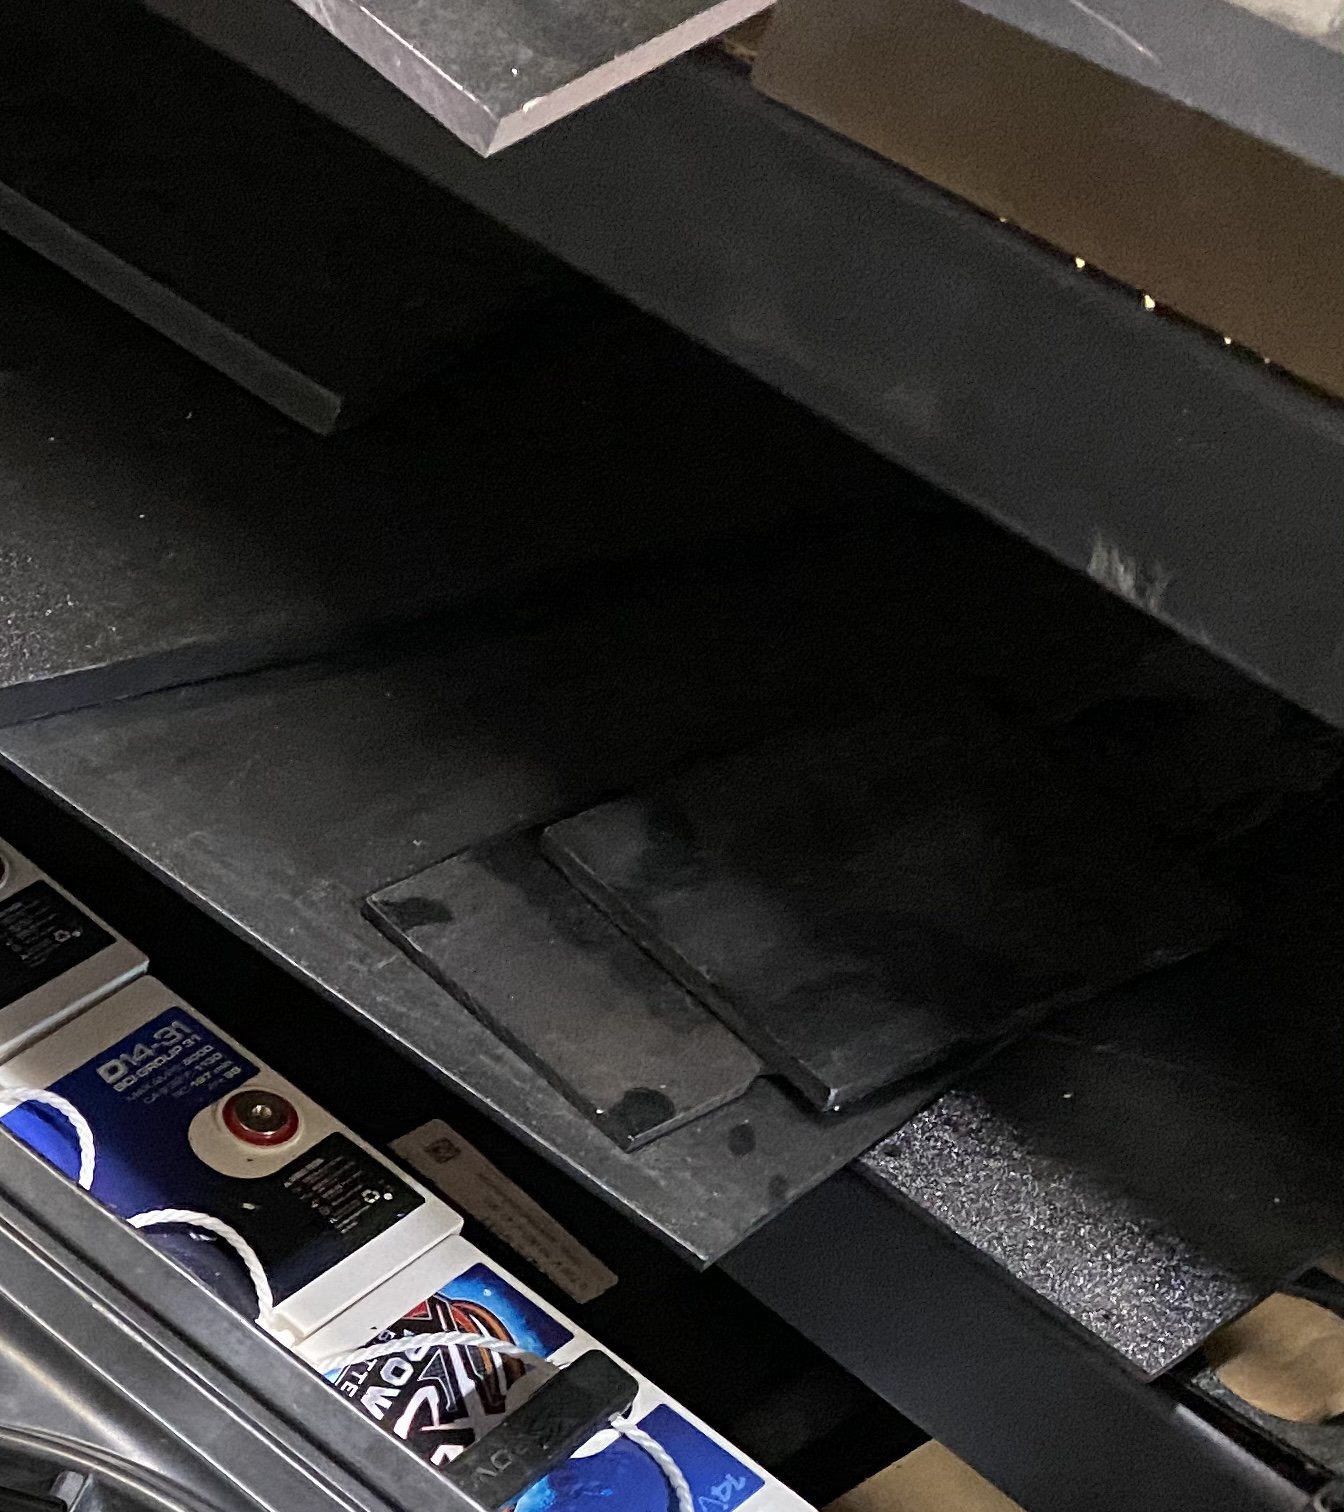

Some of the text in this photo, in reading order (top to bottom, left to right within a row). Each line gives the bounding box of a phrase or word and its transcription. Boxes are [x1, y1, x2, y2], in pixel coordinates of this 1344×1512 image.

[96, 1020, 192, 1085] D14-31
[135, 1045, 183, 1078] GROUP
[182, 1034, 202, 1049] 31
[340, 1328, 396, 1398] BTTE
